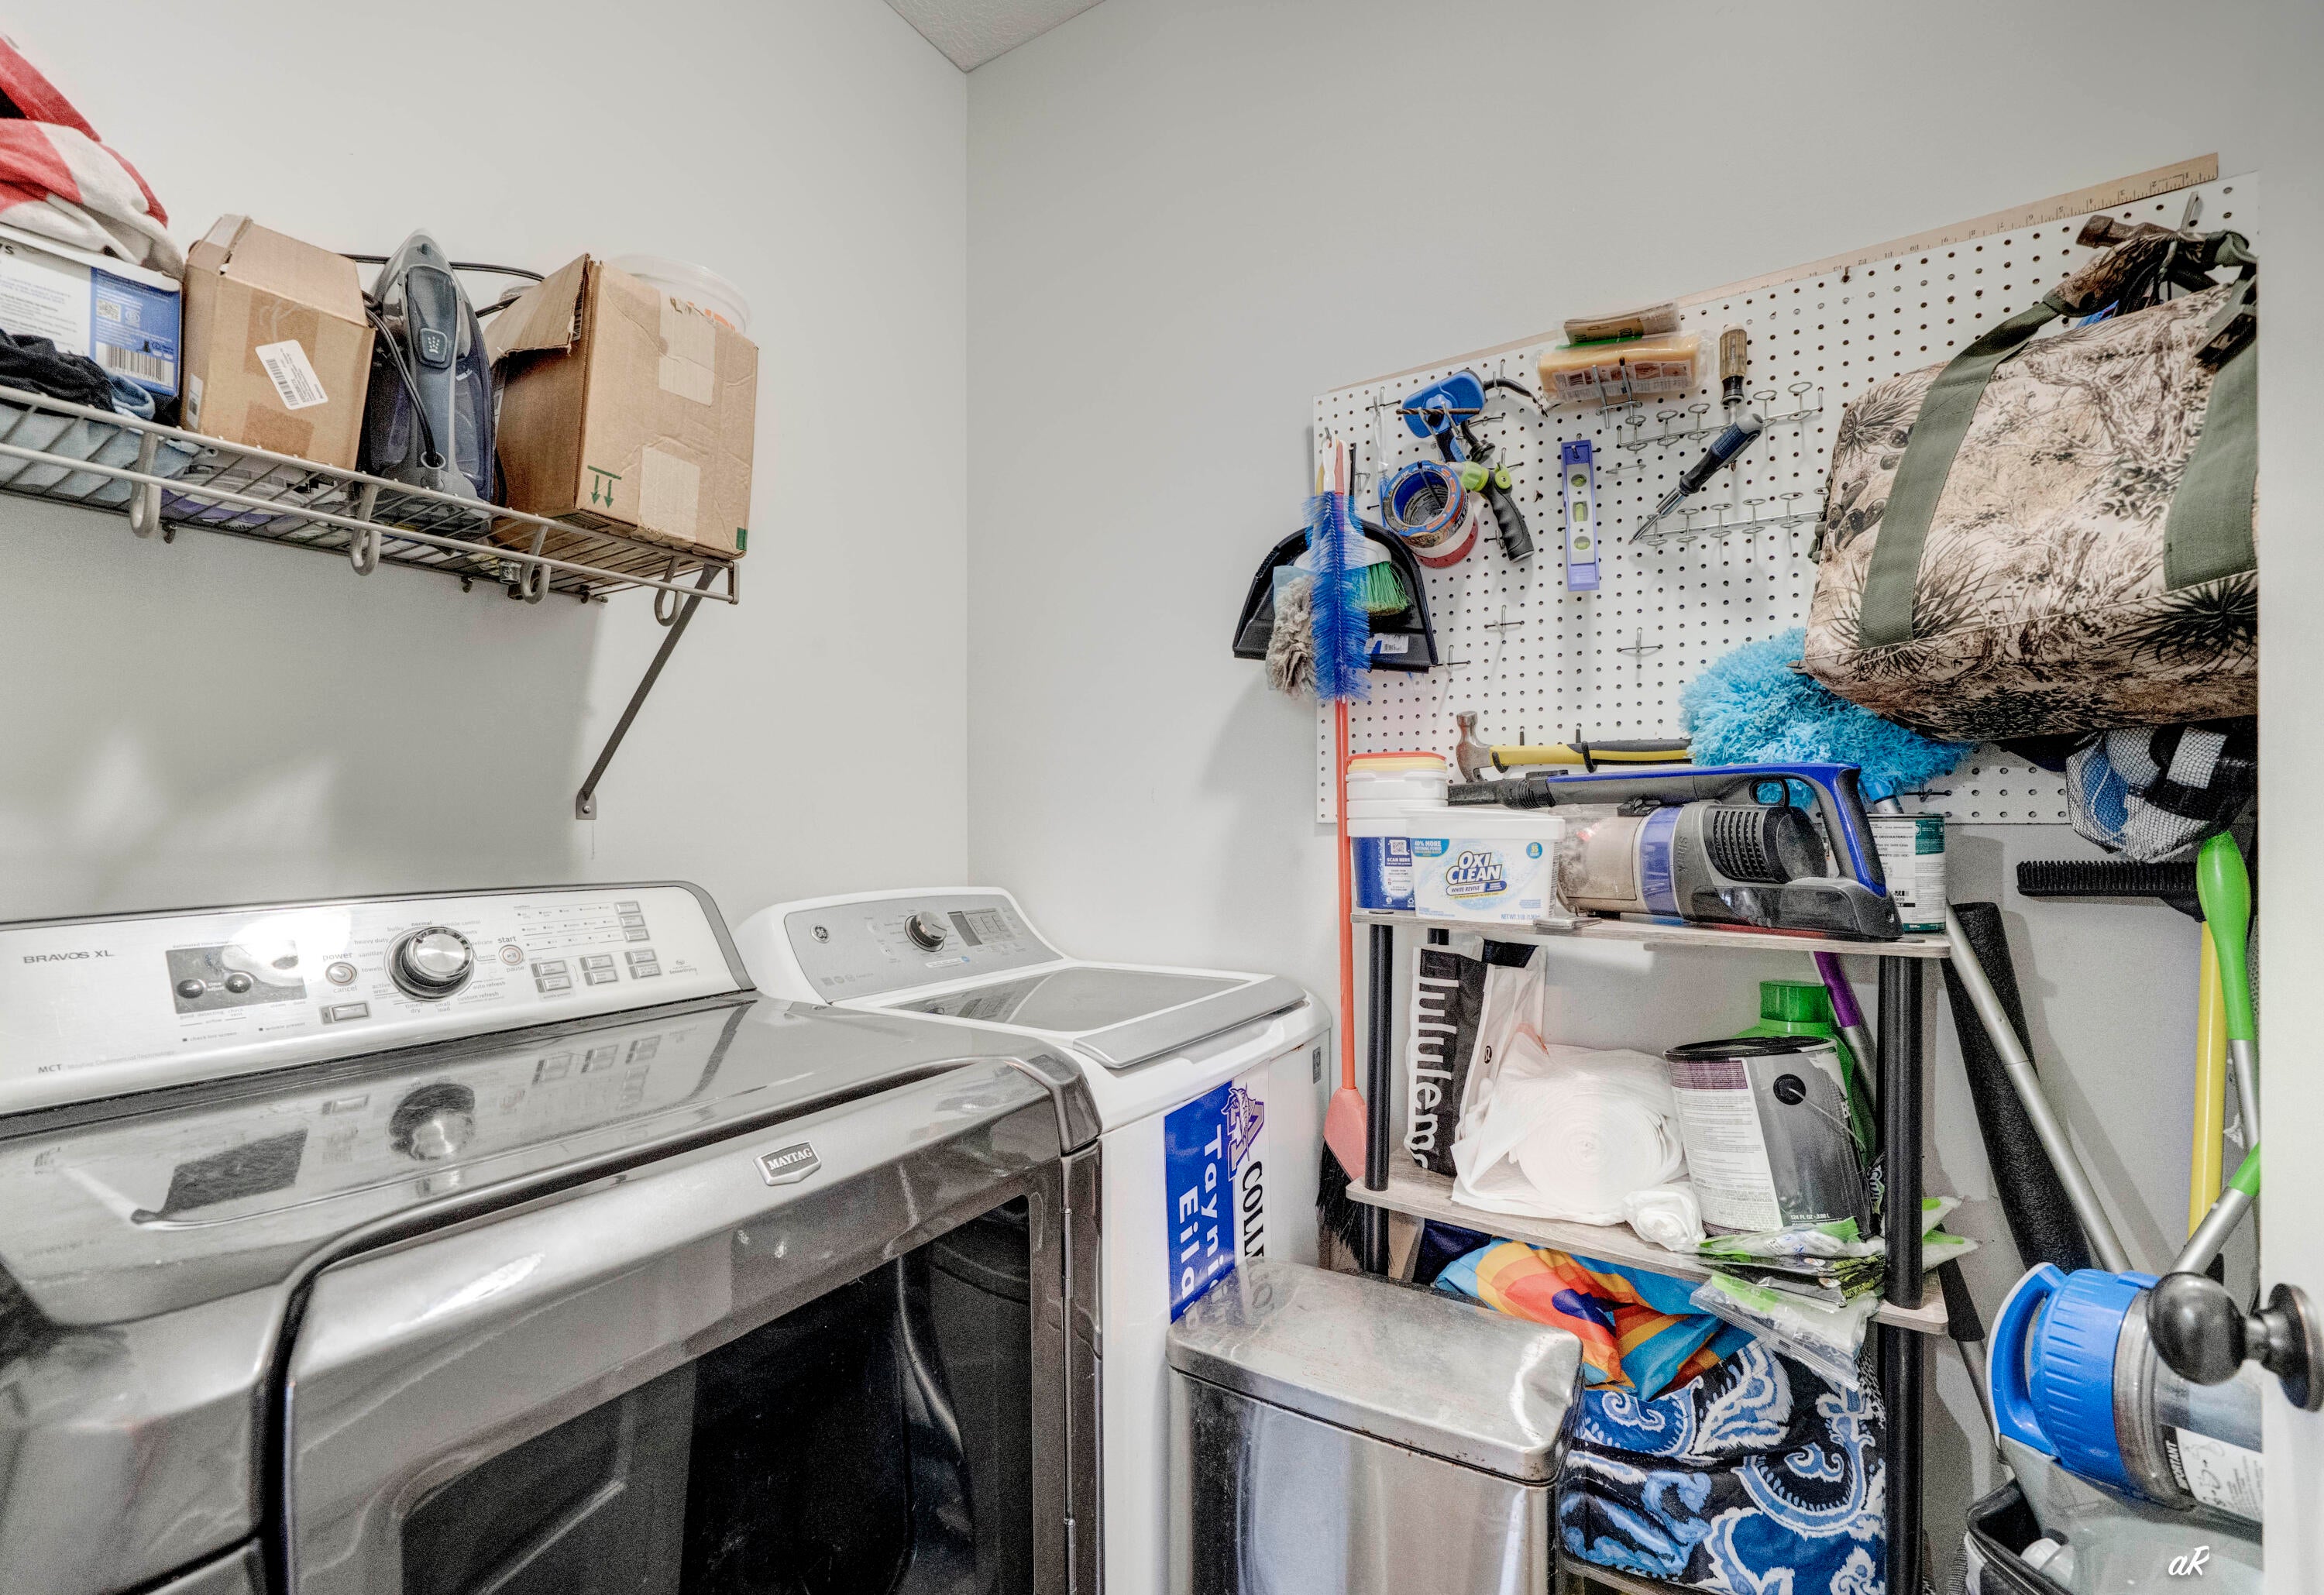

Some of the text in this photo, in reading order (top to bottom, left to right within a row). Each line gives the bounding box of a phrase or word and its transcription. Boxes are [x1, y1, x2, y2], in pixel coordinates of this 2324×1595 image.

[1458, 851, 1491, 869] OXI
[1446, 865, 1502, 885] CLEAN
[23, 950, 115, 964] BRAVOS XL
[323, 951, 352, 961] power
[38, 1064, 62, 1073] MCT
[766, 1147, 813, 1170] MAYTAG
[1202, 1124, 1222, 1289] Tayni
[1179, 1185, 1200, 1315] Eila
